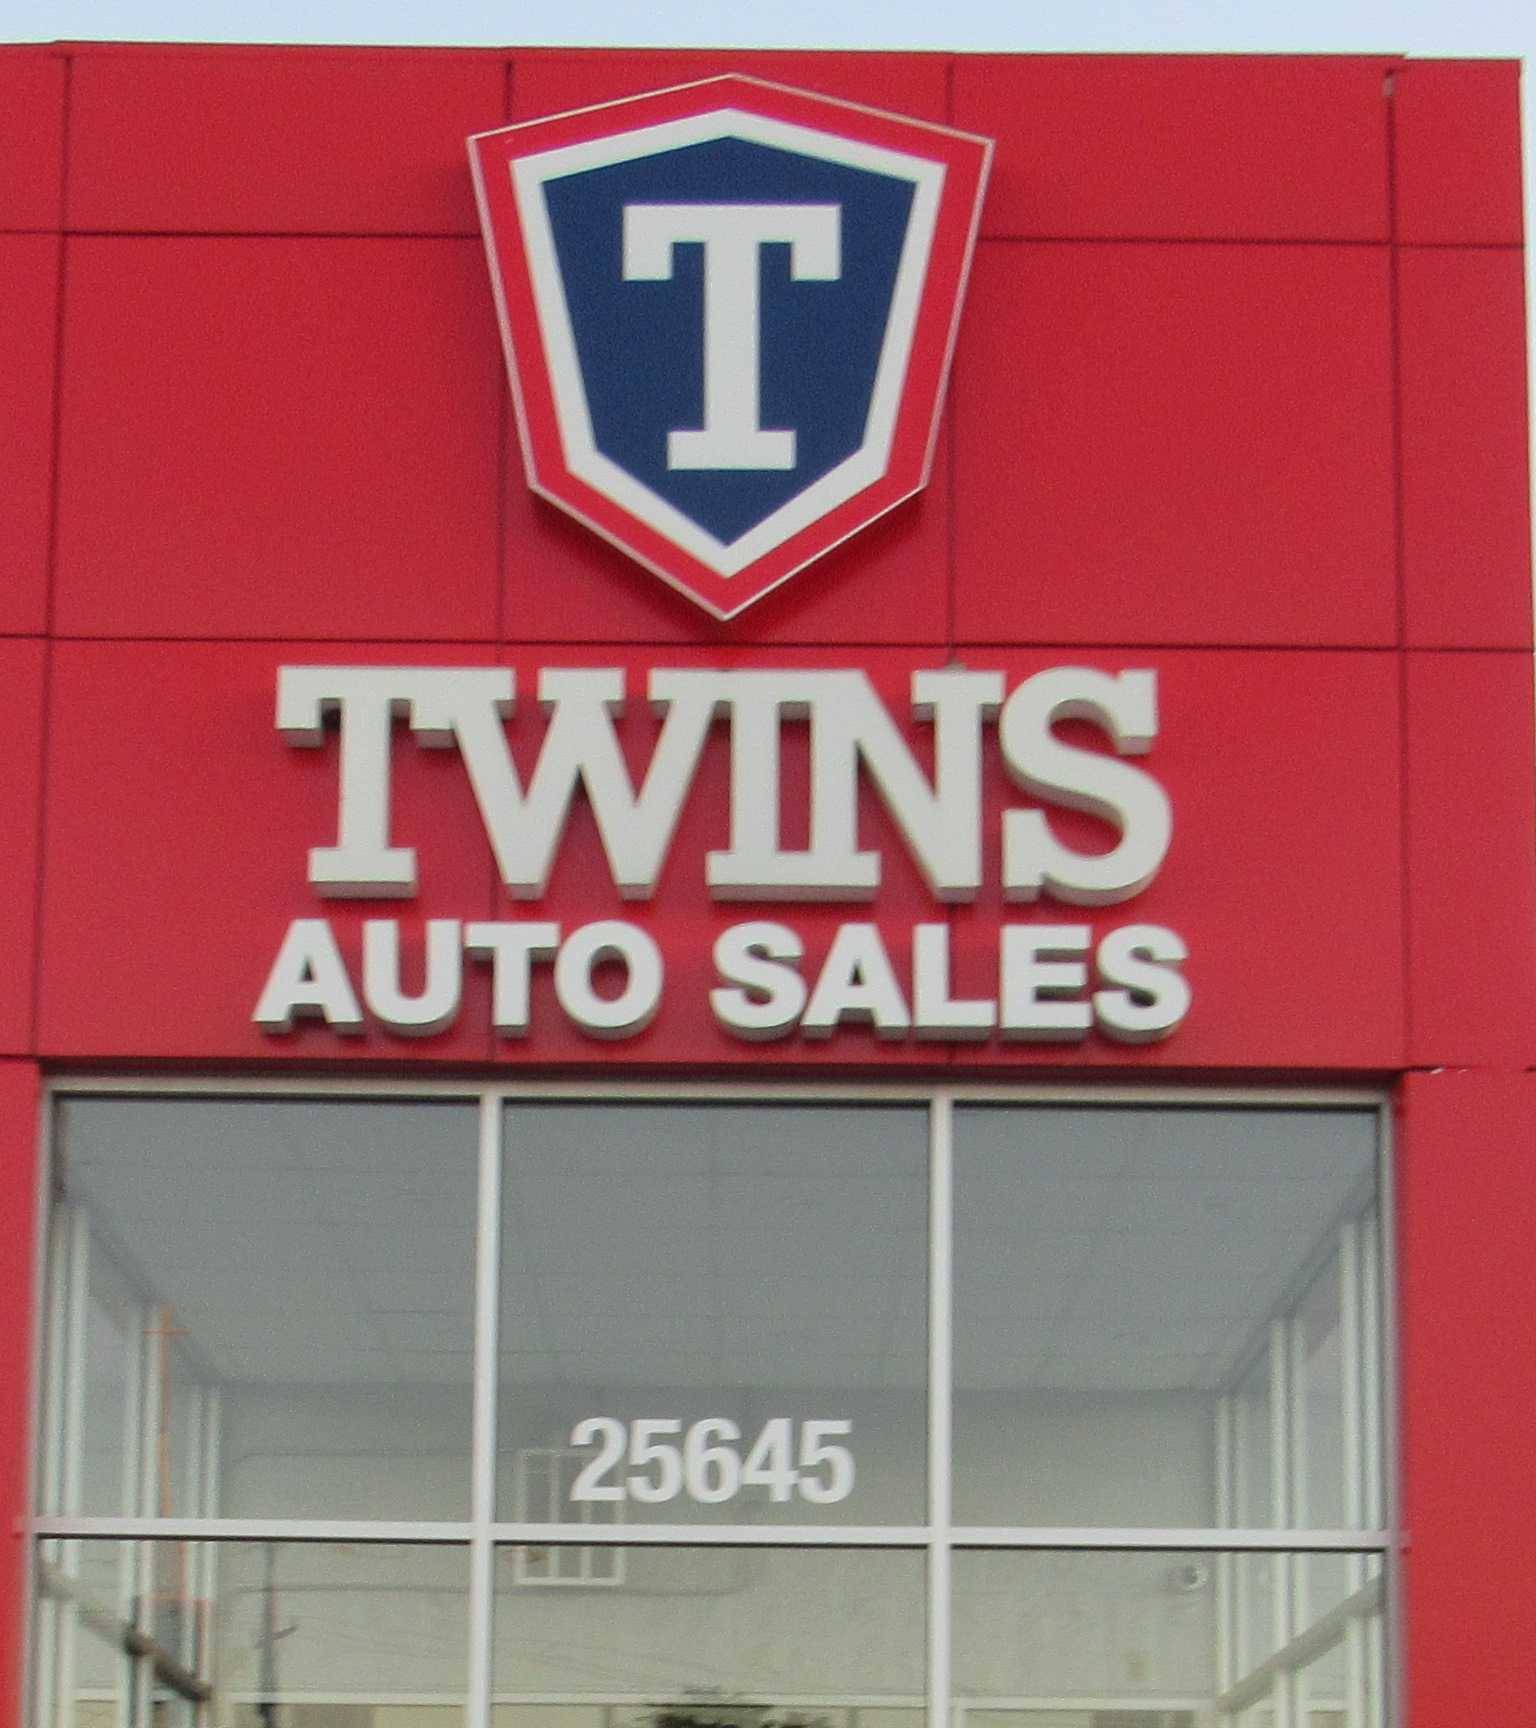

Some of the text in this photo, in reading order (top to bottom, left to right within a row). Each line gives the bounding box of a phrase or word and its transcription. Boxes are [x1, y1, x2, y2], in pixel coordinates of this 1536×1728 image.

[623, 205, 841, 470] T
[275, 664, 1173, 905] TWINS
[252, 919, 1192, 1042] AUTO SALES
[569, 1416, 856, 1504] 25645
